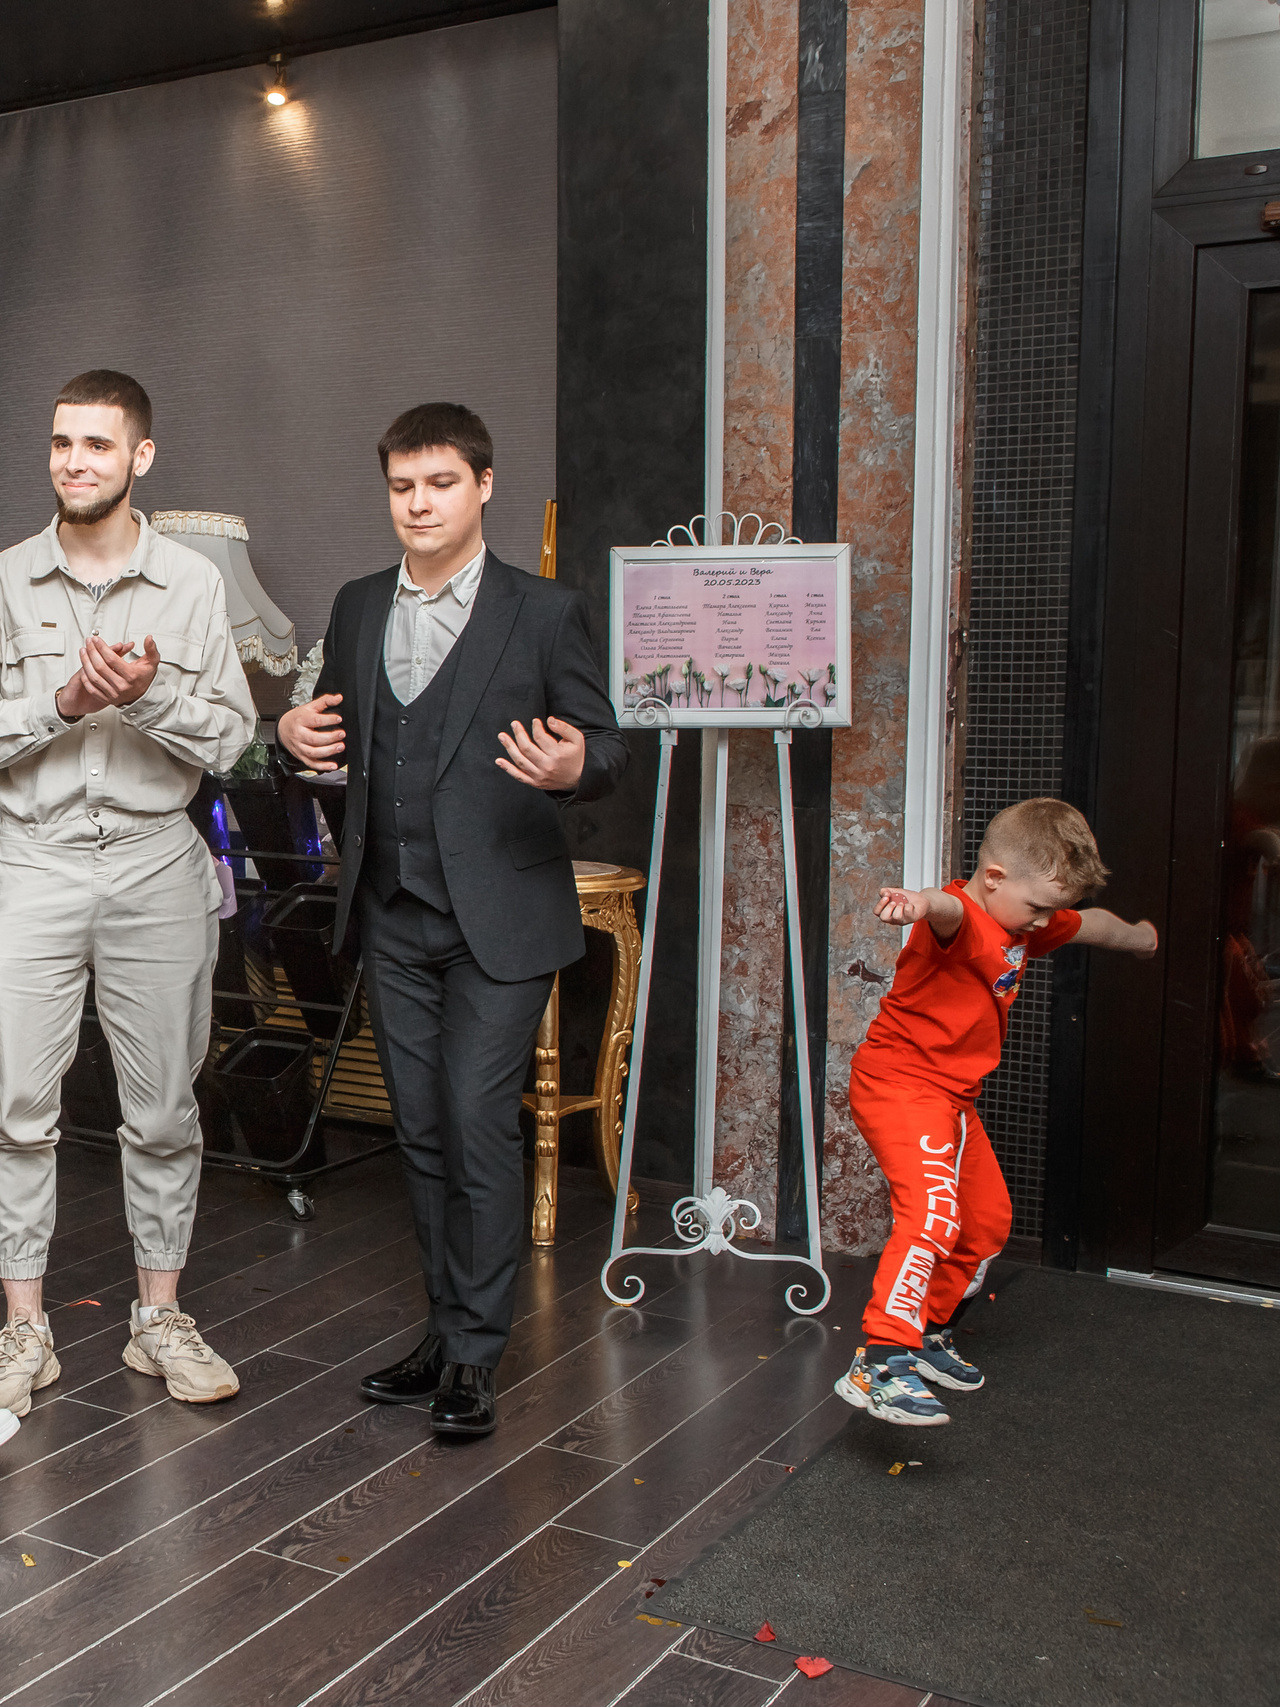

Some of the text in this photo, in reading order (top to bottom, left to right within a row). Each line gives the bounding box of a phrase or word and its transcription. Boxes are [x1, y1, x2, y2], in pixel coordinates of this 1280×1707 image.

[693, 568, 737, 577] Валерий
[750, 568, 774, 577] Вера
[892, 1253, 934, 1321] WEAR
